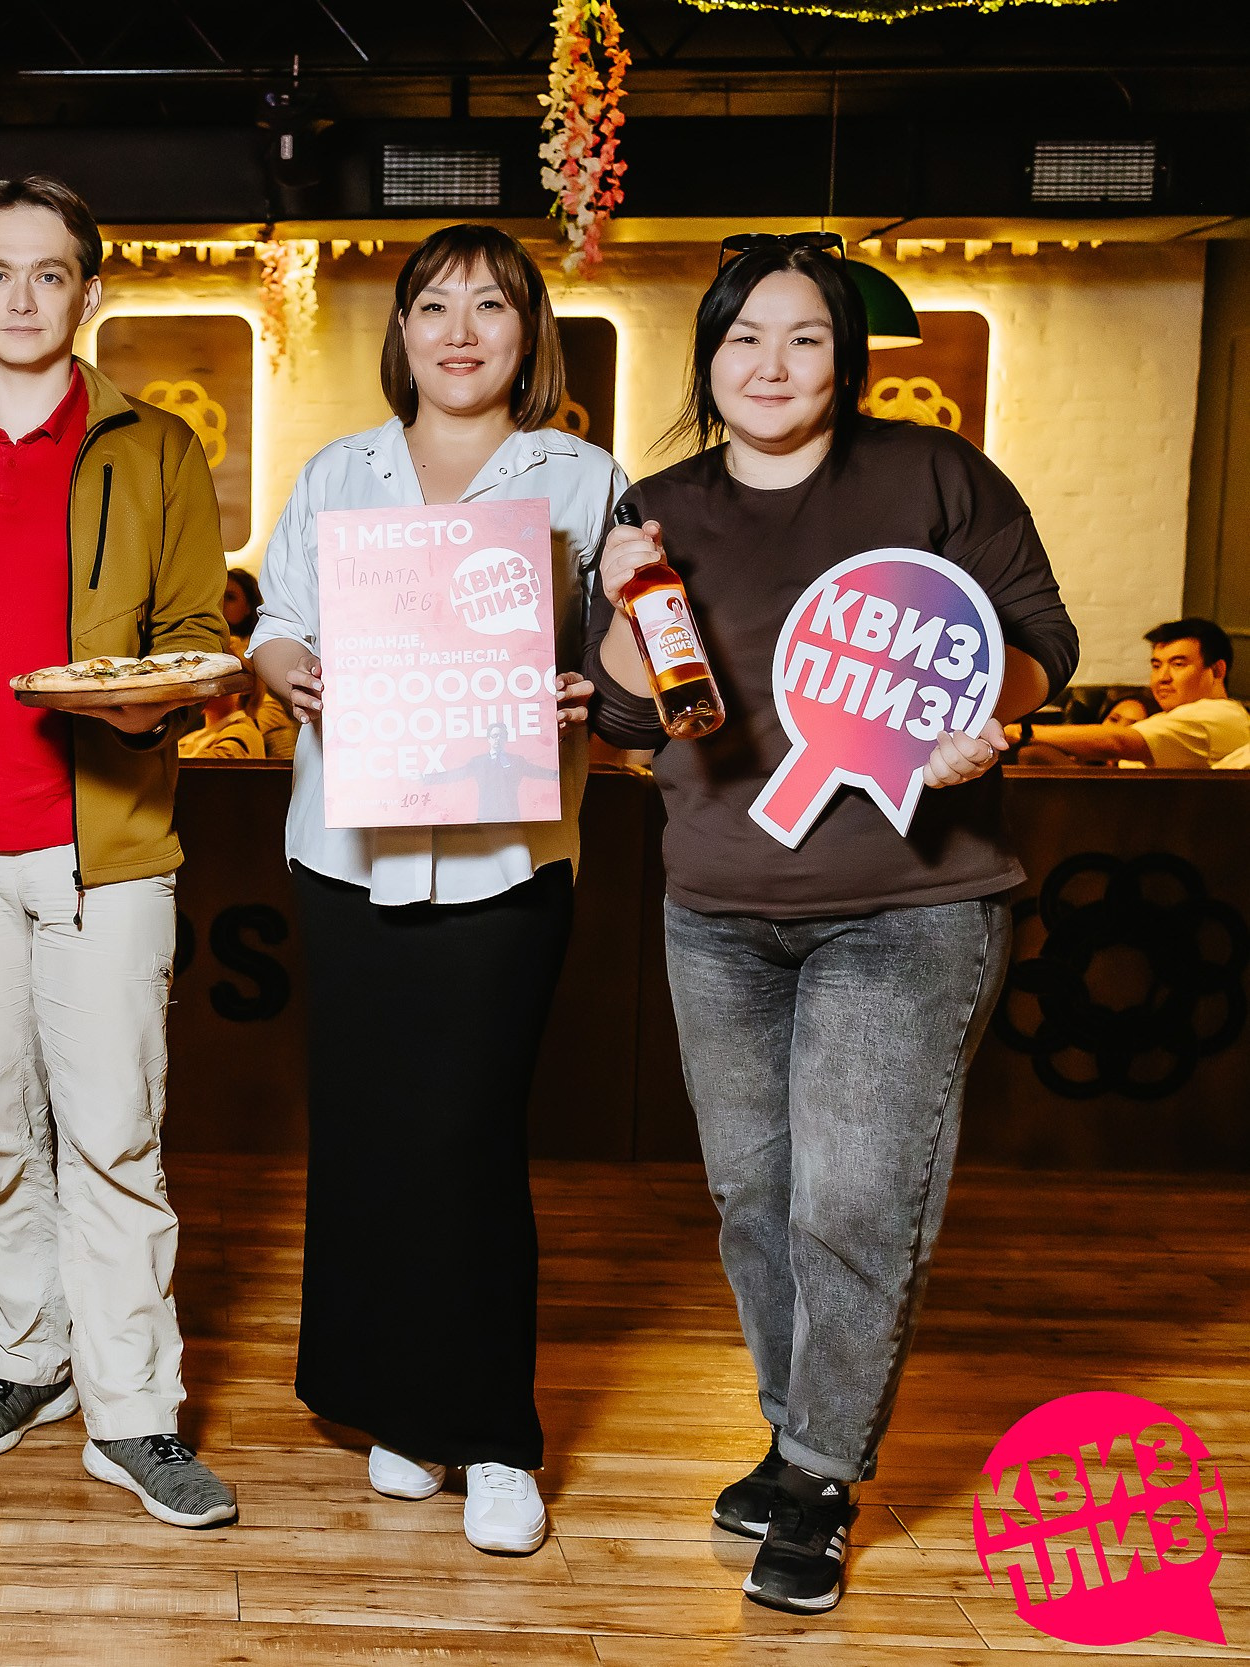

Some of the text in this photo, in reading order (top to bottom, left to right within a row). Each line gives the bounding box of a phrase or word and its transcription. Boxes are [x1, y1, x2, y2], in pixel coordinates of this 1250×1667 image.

[334, 519, 474, 551] 1 МЕСТО
[454, 578, 541, 625] ПЛИЗ!
[334, 634, 425, 650] КОМАНДЕ,
[334, 648, 510, 670] КОТОРАЯ РАЗНЕСЛА
[338, 743, 448, 781] ВСЕХ
